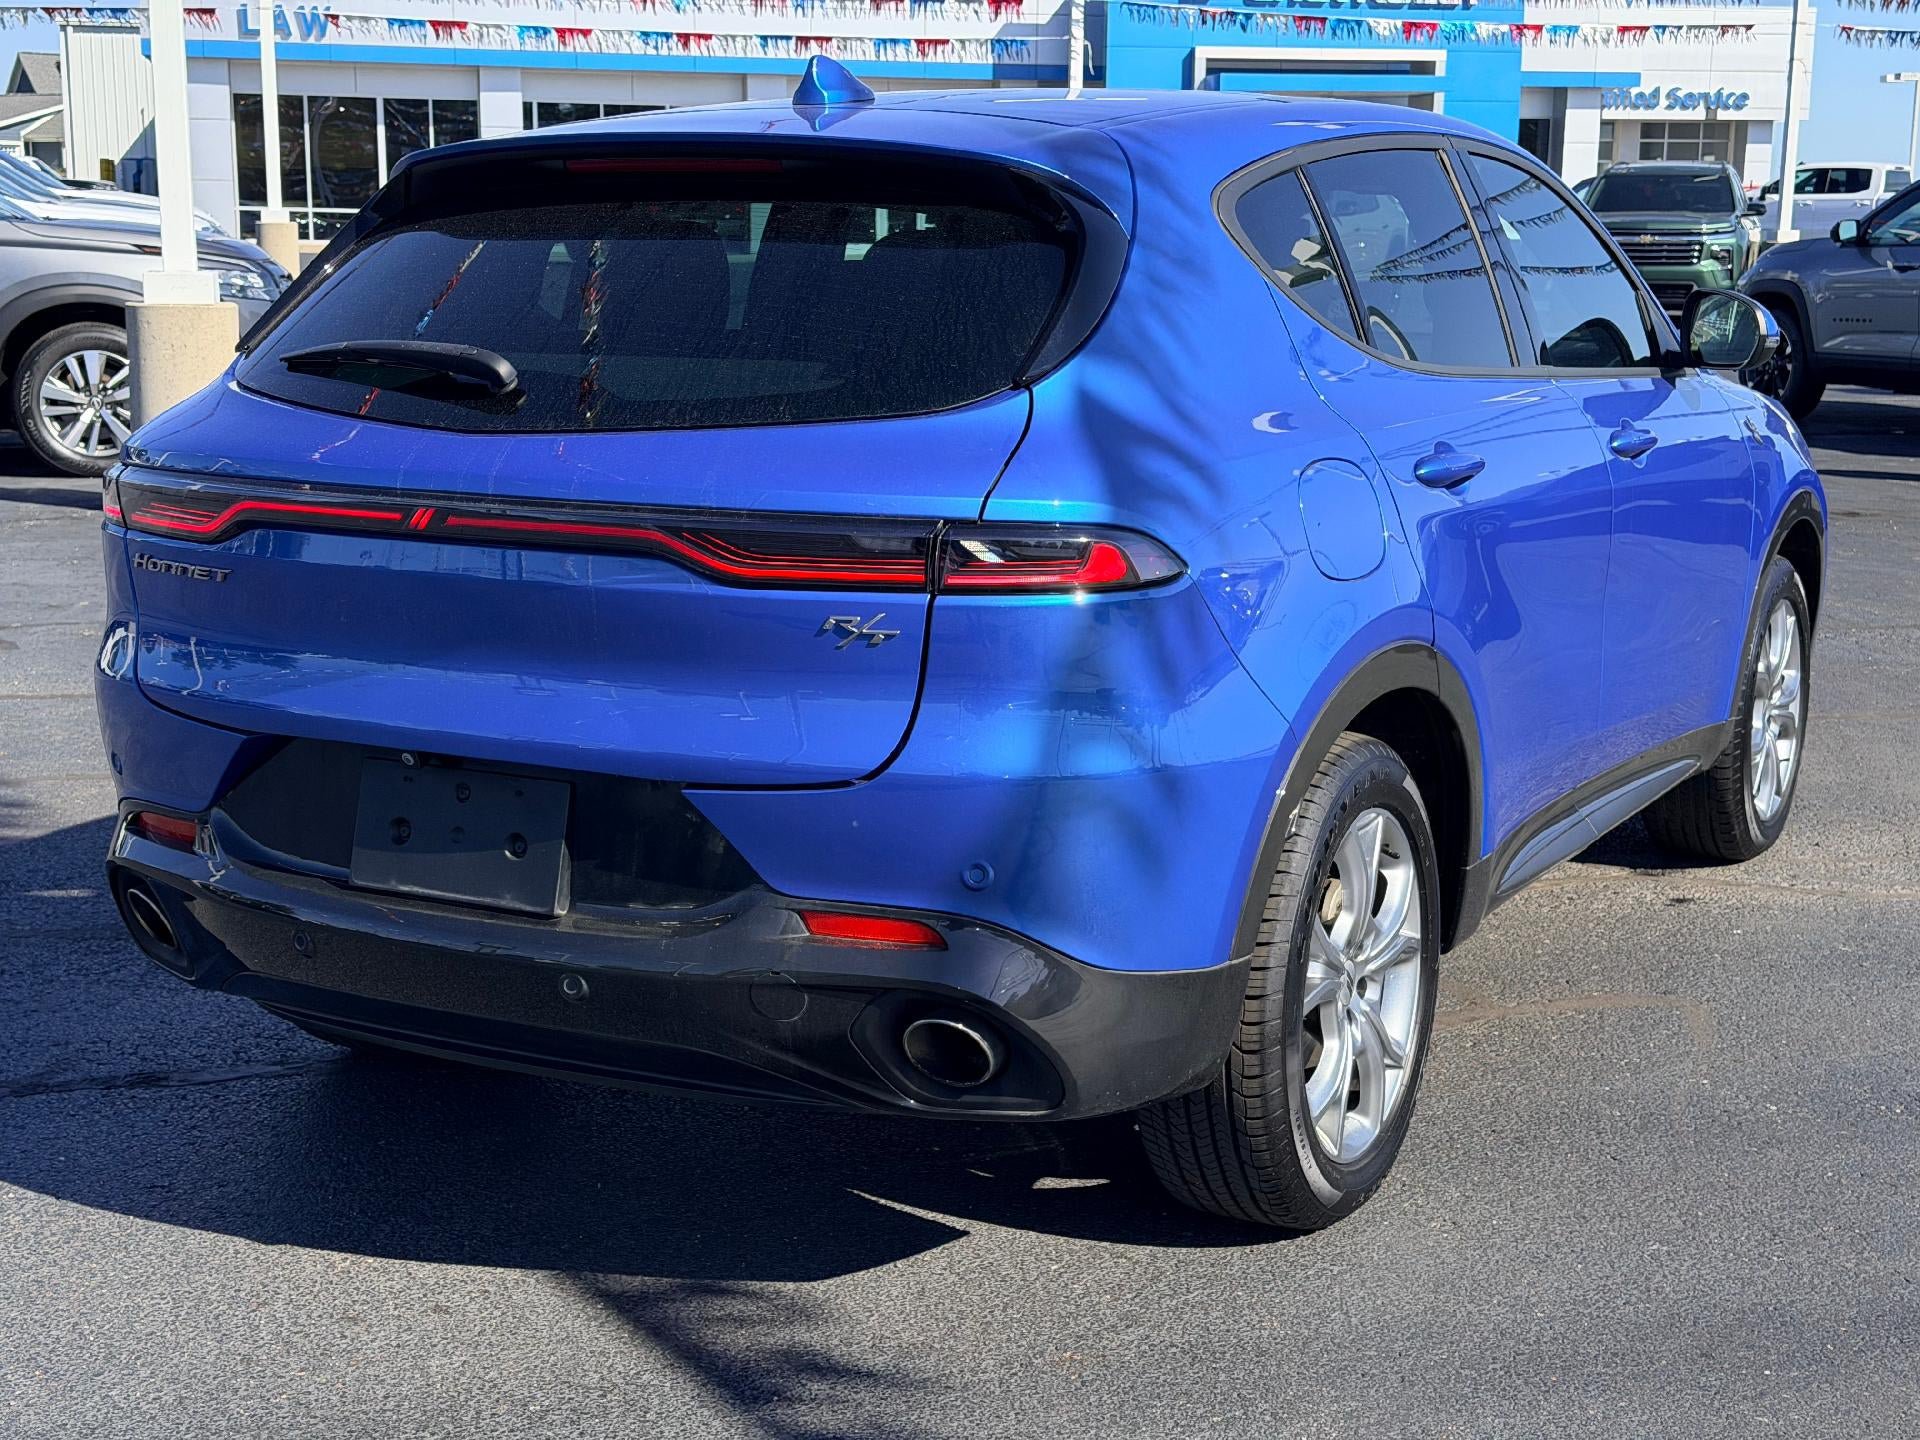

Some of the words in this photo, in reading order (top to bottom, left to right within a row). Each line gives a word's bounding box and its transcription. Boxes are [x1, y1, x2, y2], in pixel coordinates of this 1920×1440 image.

[236, 4, 331, 41] LAW
[1664, 87, 1750, 111] Service
[133, 553, 232, 582] HORNET
[819, 612, 900, 650] R/T
